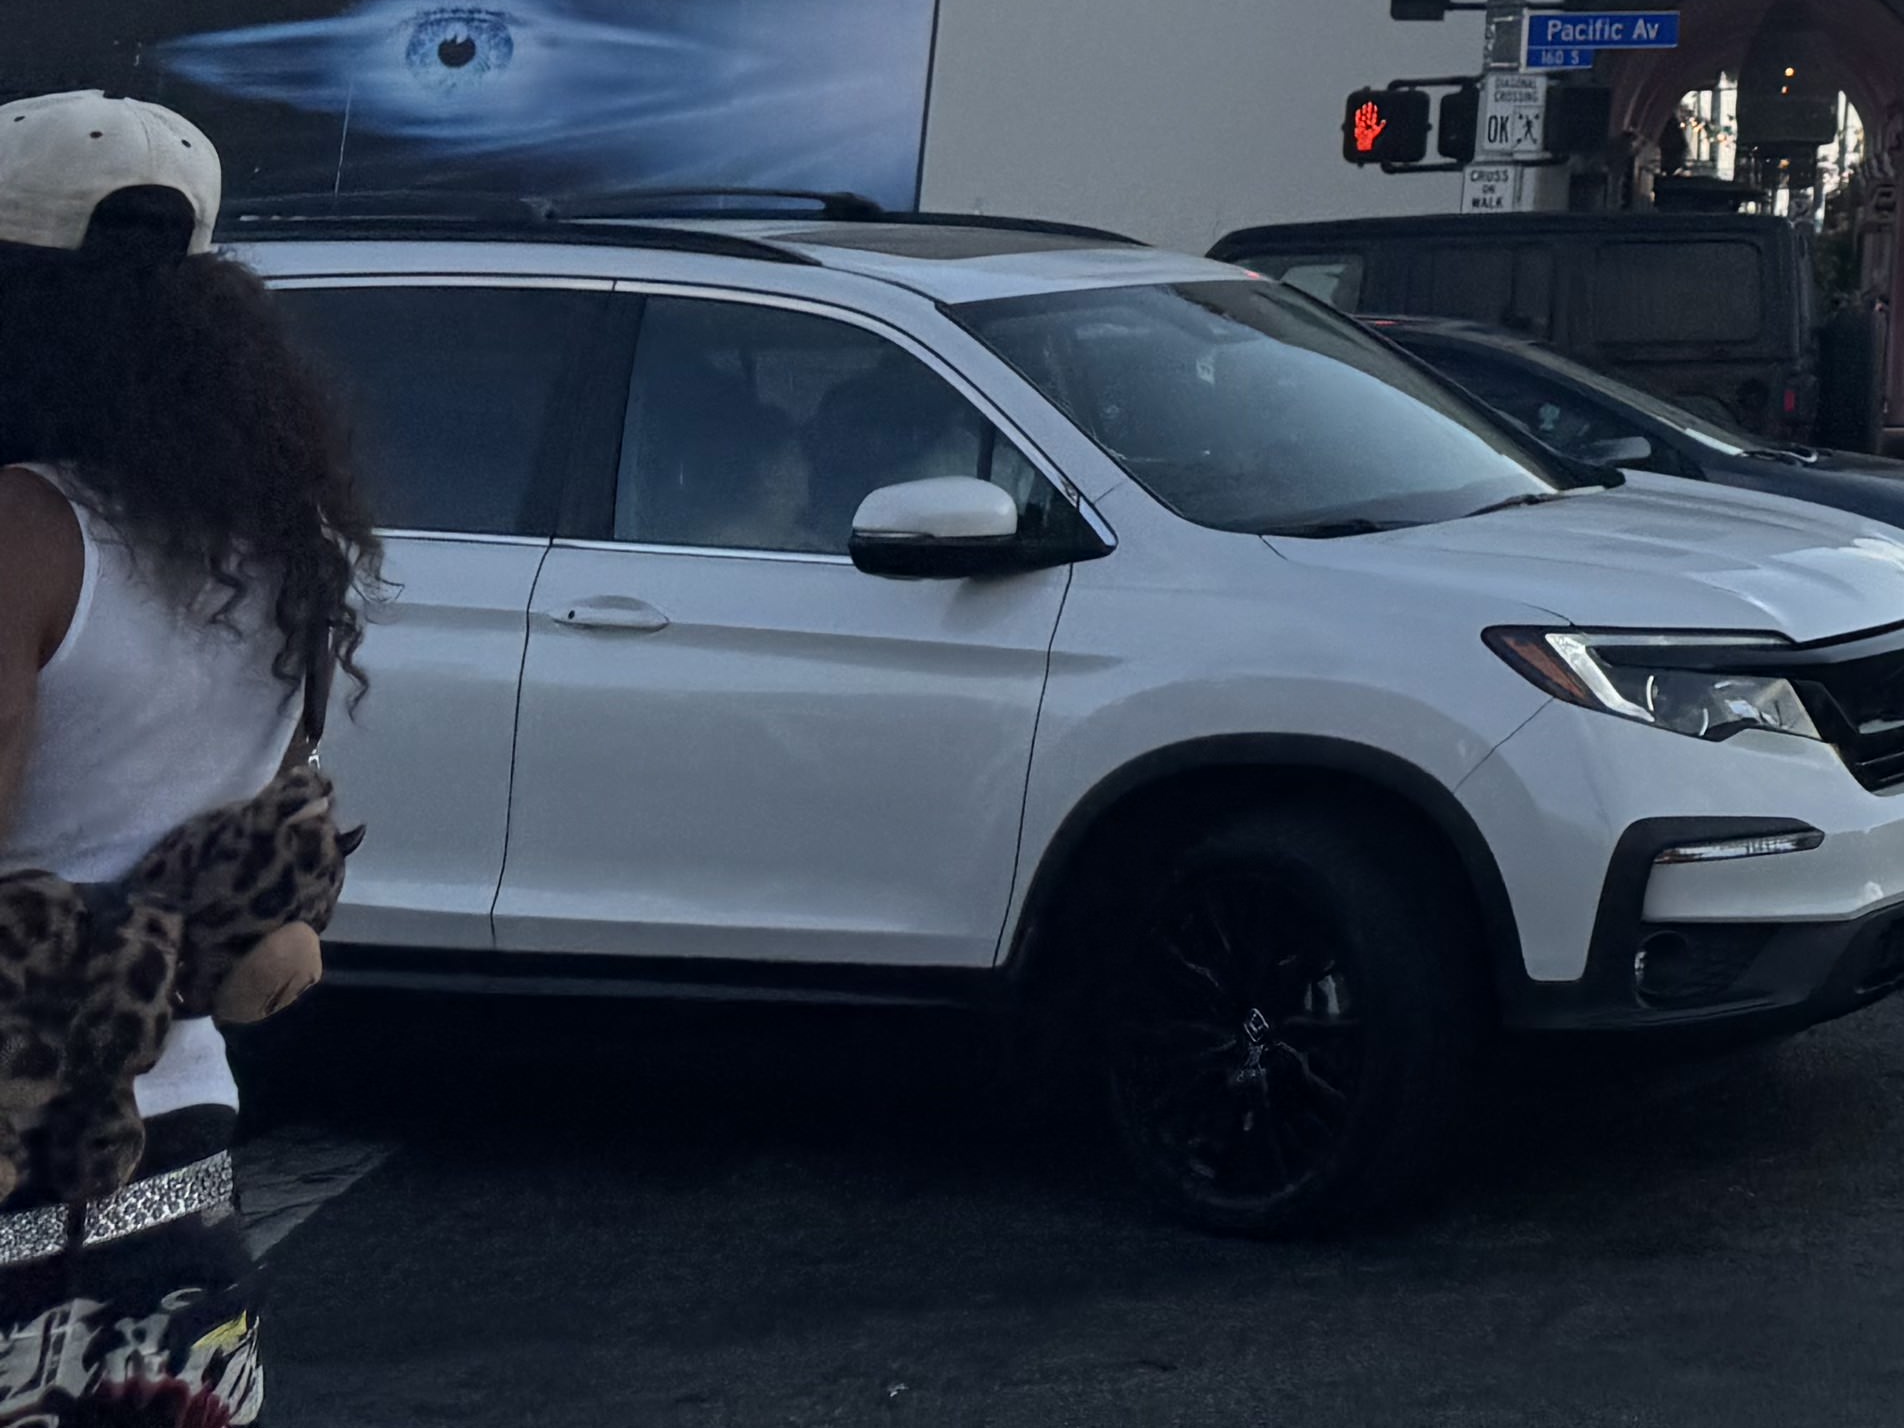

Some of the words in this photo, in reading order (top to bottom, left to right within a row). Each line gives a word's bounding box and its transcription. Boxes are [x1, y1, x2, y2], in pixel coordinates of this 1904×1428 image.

[1547, 18, 1623, 41] Pacific
[1632, 18, 1660, 40] Av
[1488, 114, 1509, 143] OK
[1472, 197, 1504, 209] WALK
